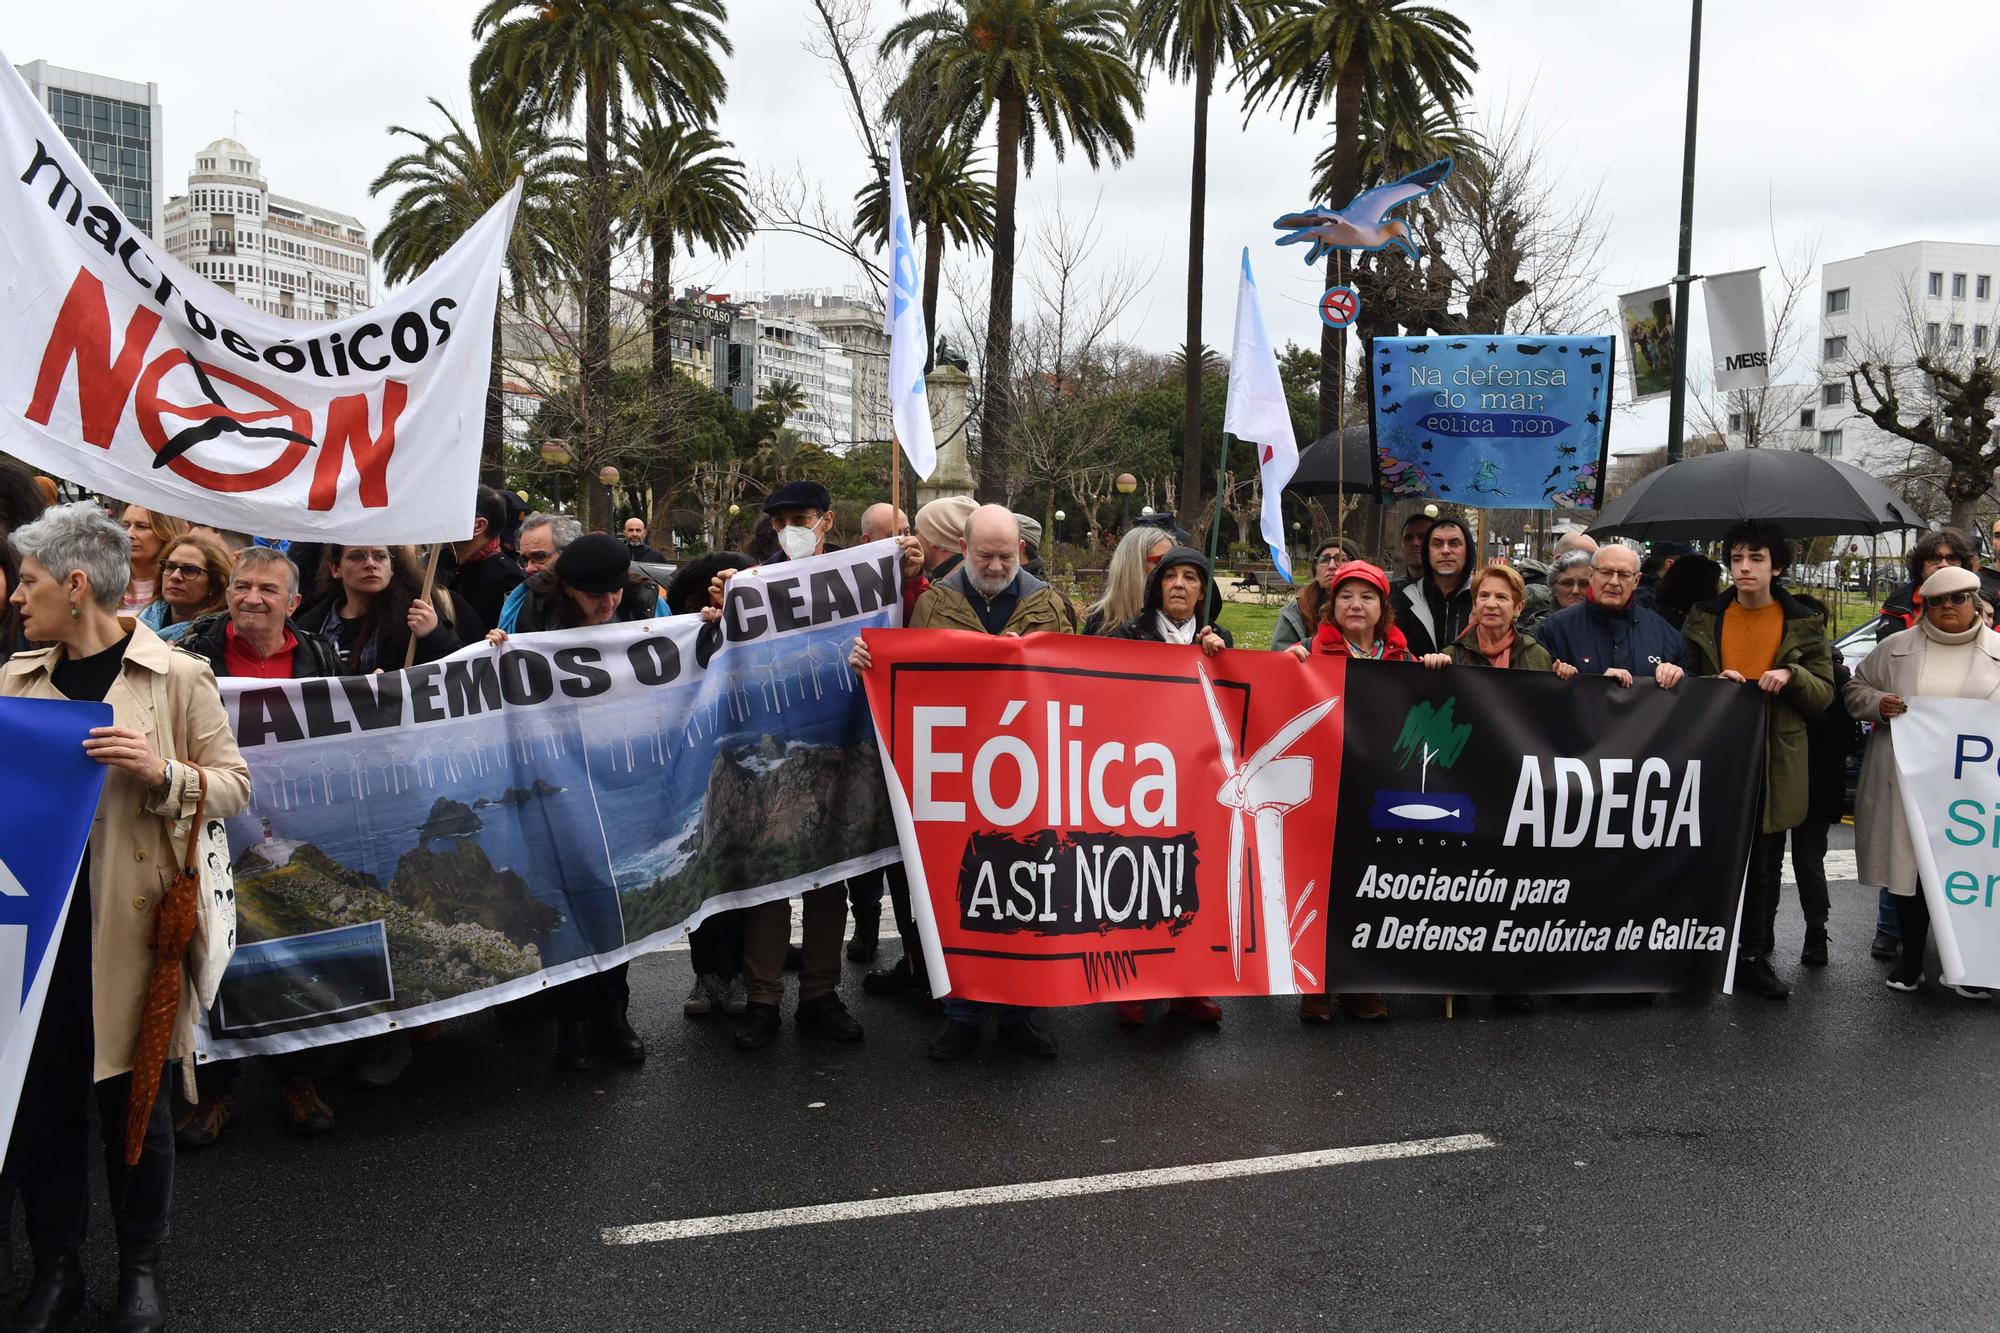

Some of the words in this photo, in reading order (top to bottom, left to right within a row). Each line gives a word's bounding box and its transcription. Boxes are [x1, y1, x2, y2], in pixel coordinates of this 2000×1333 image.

[21, 138, 458, 378] macroeólicos
[702, 307, 730, 323] OCASO
[784, 286, 832, 301] PASTOR
[25, 264, 408, 512] NON
[1410, 365, 1443, 387] Na
[1452, 364, 1568, 387] defensa
[1433, 388, 1466, 409] do
[1511, 418, 1556, 434] non
[220, 646, 612, 747] ALVEMOS
[626, 636, 681, 687] O
[696, 553, 905, 670] OCEAN
[912, 700, 1178, 828] Eólica
[1953, 733, 2000, 780] P
[1502, 754, 1702, 850] ADEGA
[1376, 836, 1467, 847] ADEGA
[967, 847, 1058, 923] ASÍ
[1073, 843, 1186, 923] NON!
[1355, 864, 1511, 904] Asociación
[1511, 874, 1571, 911] para
[1351, 922, 1372, 950] a
[1376, 916, 1487, 952] Defensa
[1491, 918, 1610, 953] Ecolóxica
[1614, 919, 1644, 952] de
[1648, 916, 1727, 952] Galiza
